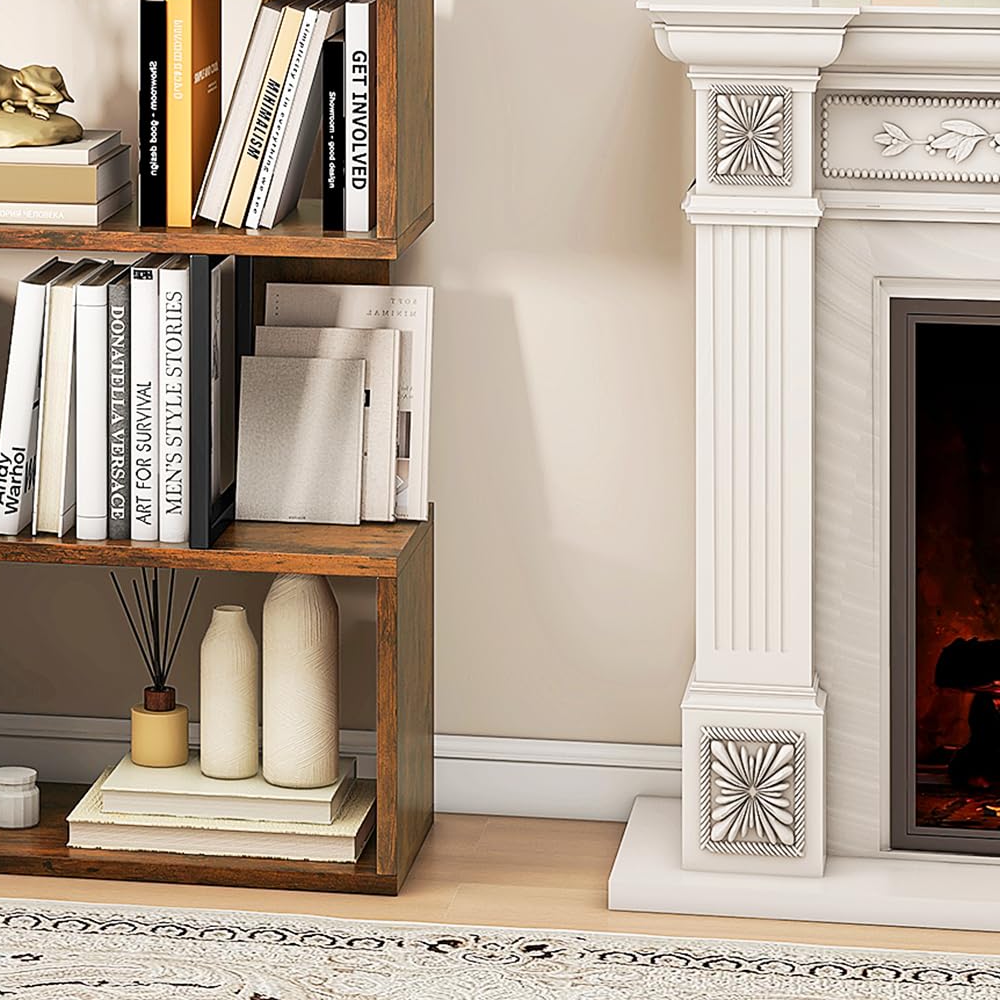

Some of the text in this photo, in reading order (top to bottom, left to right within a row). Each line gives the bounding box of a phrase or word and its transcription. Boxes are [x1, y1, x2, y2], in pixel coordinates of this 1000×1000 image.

[246, 78, 281, 160] MINIMALISM
[328, 91, 336, 134] Showroom
[328, 141, 336, 161] good
[352, 50, 368, 190] GET INVOLVED
[328, 161, 336, 189] design
[111, 306, 125, 520] DONATELLA VERSACE
[165, 291, 183, 516] MEN'S STYLE STORIES
[4, 446, 26, 514] Warhol
[136, 381, 152, 525] ART FOR SURVIVAL
